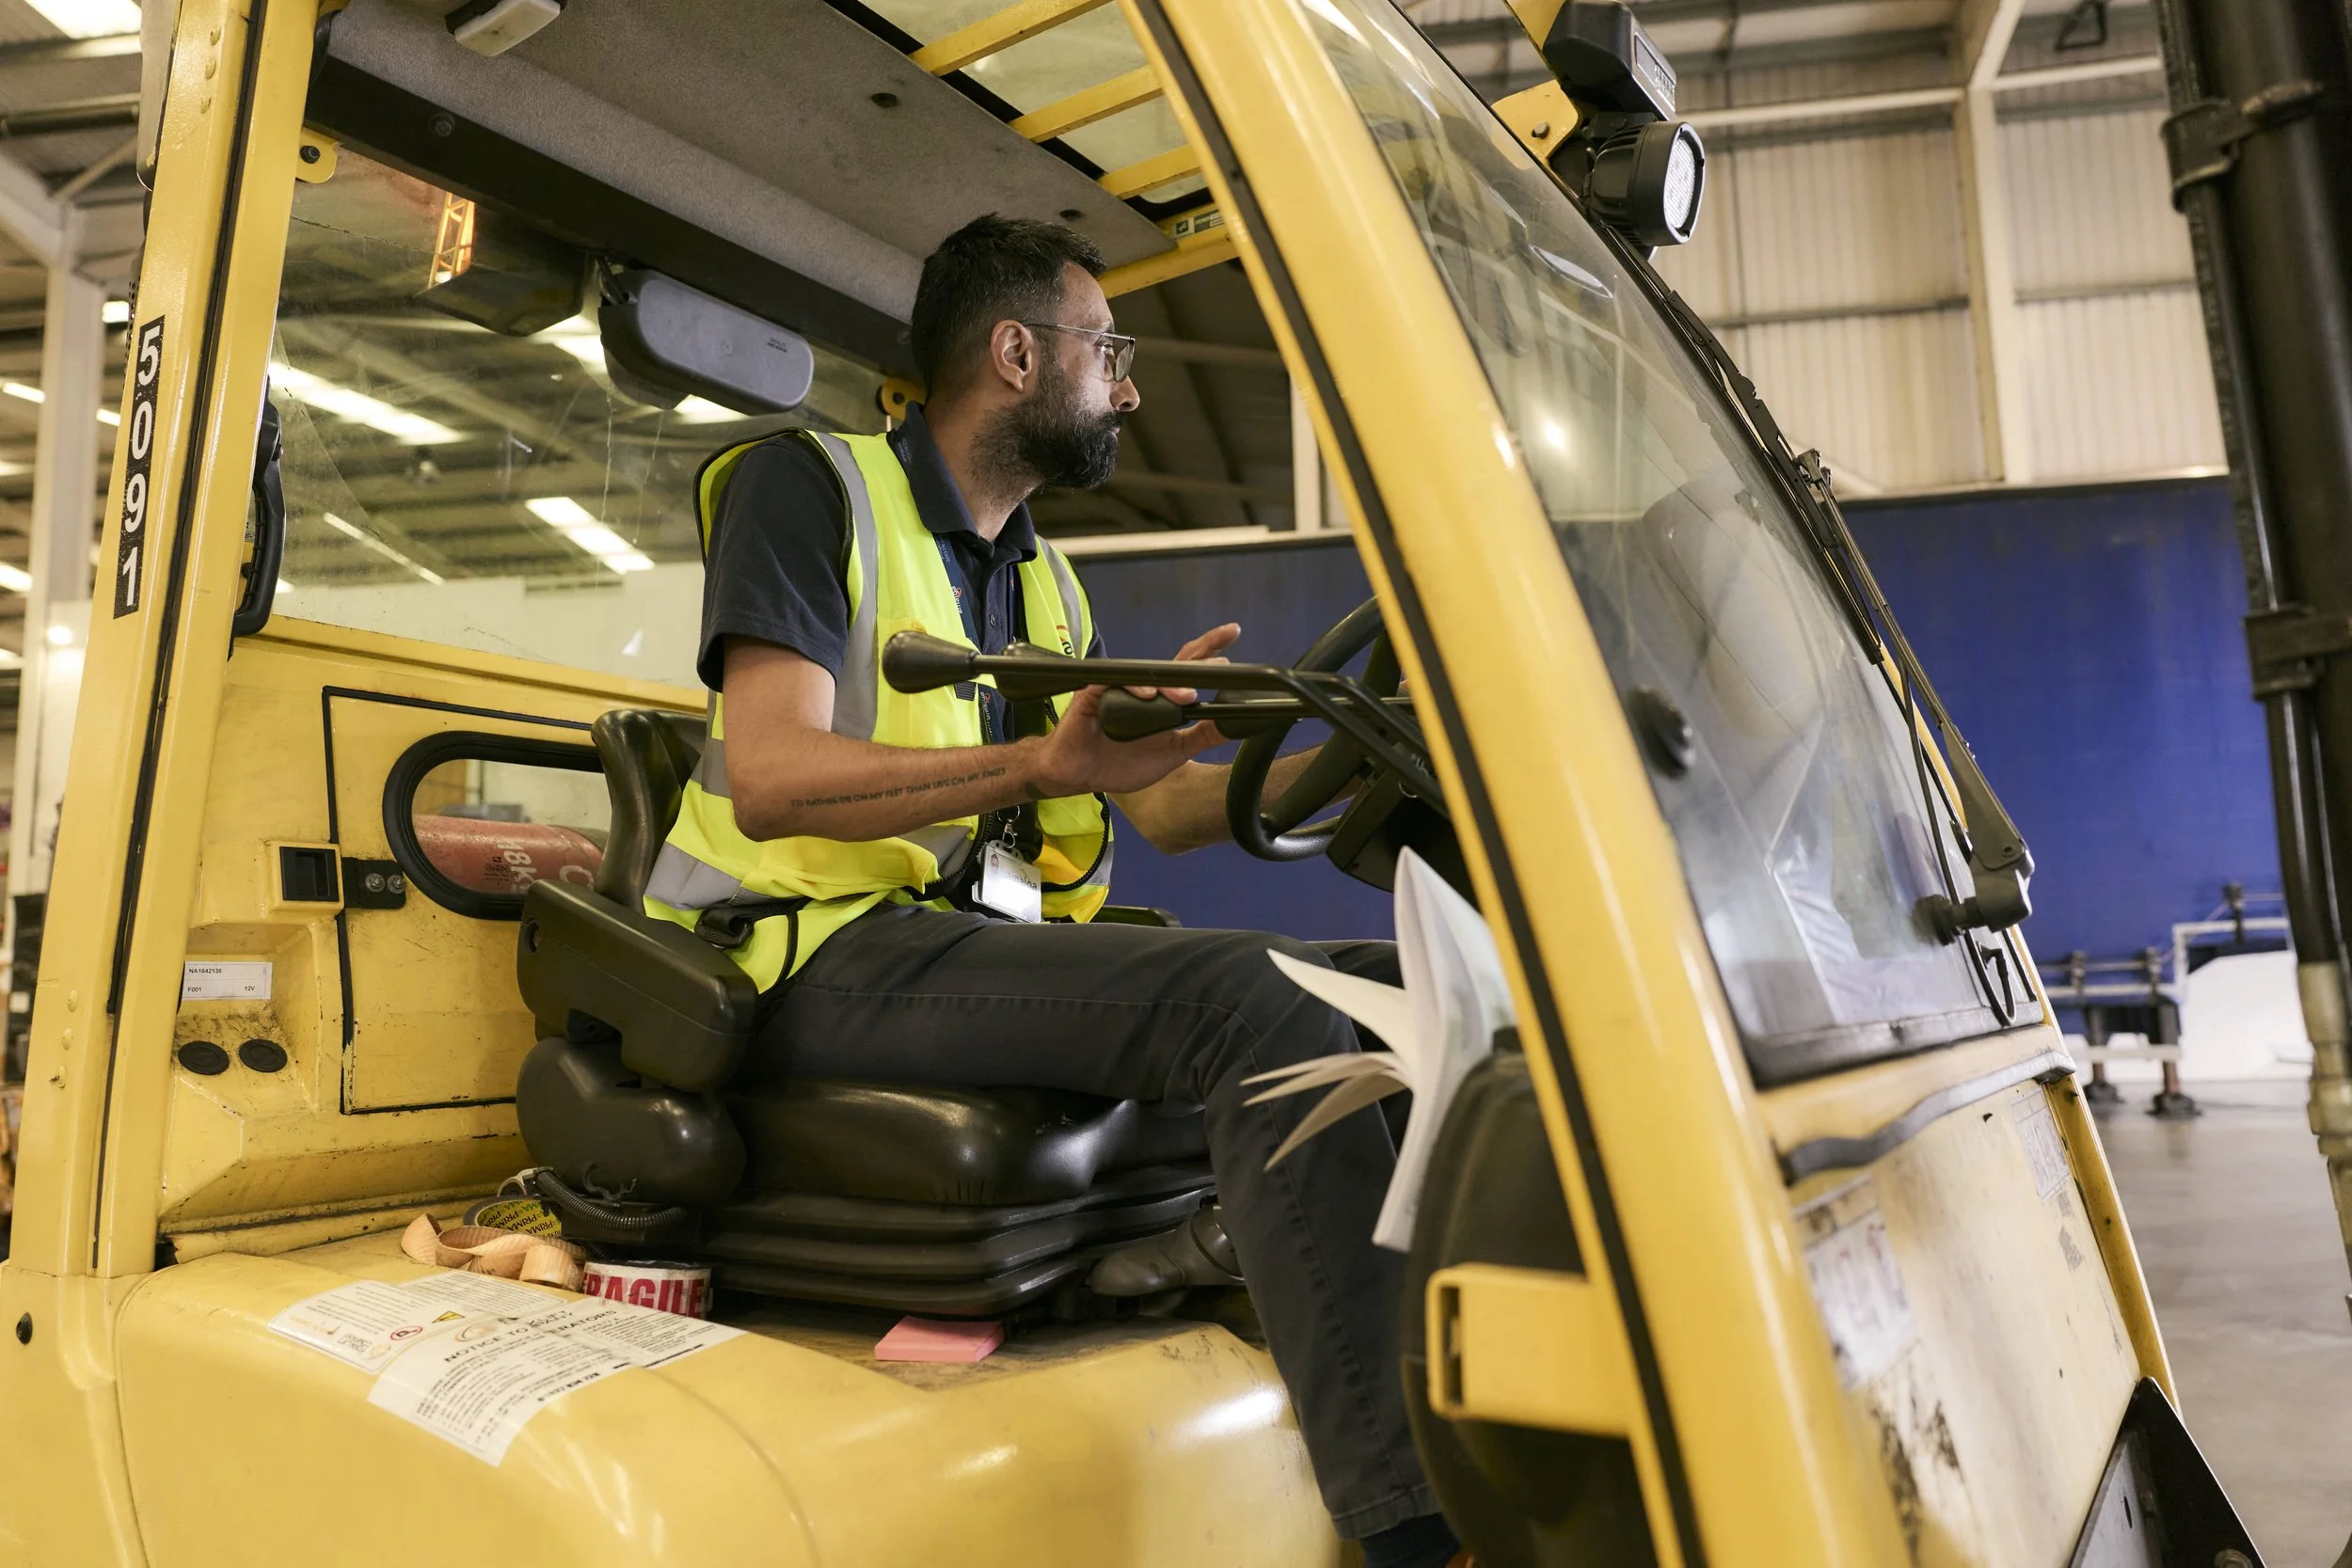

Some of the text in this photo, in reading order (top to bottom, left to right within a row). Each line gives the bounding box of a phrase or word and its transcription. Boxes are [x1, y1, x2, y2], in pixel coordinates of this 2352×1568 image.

[122, 325, 161, 607] 5091
[869, 791, 883, 800] MY
[506, 1213, 537, 1231] PRIMA
[525, 1220, 553, 1234] PRIMA
[584, 1273, 705, 1320] RAGILE
[444, 1326, 529, 1362] NOTICE TO
